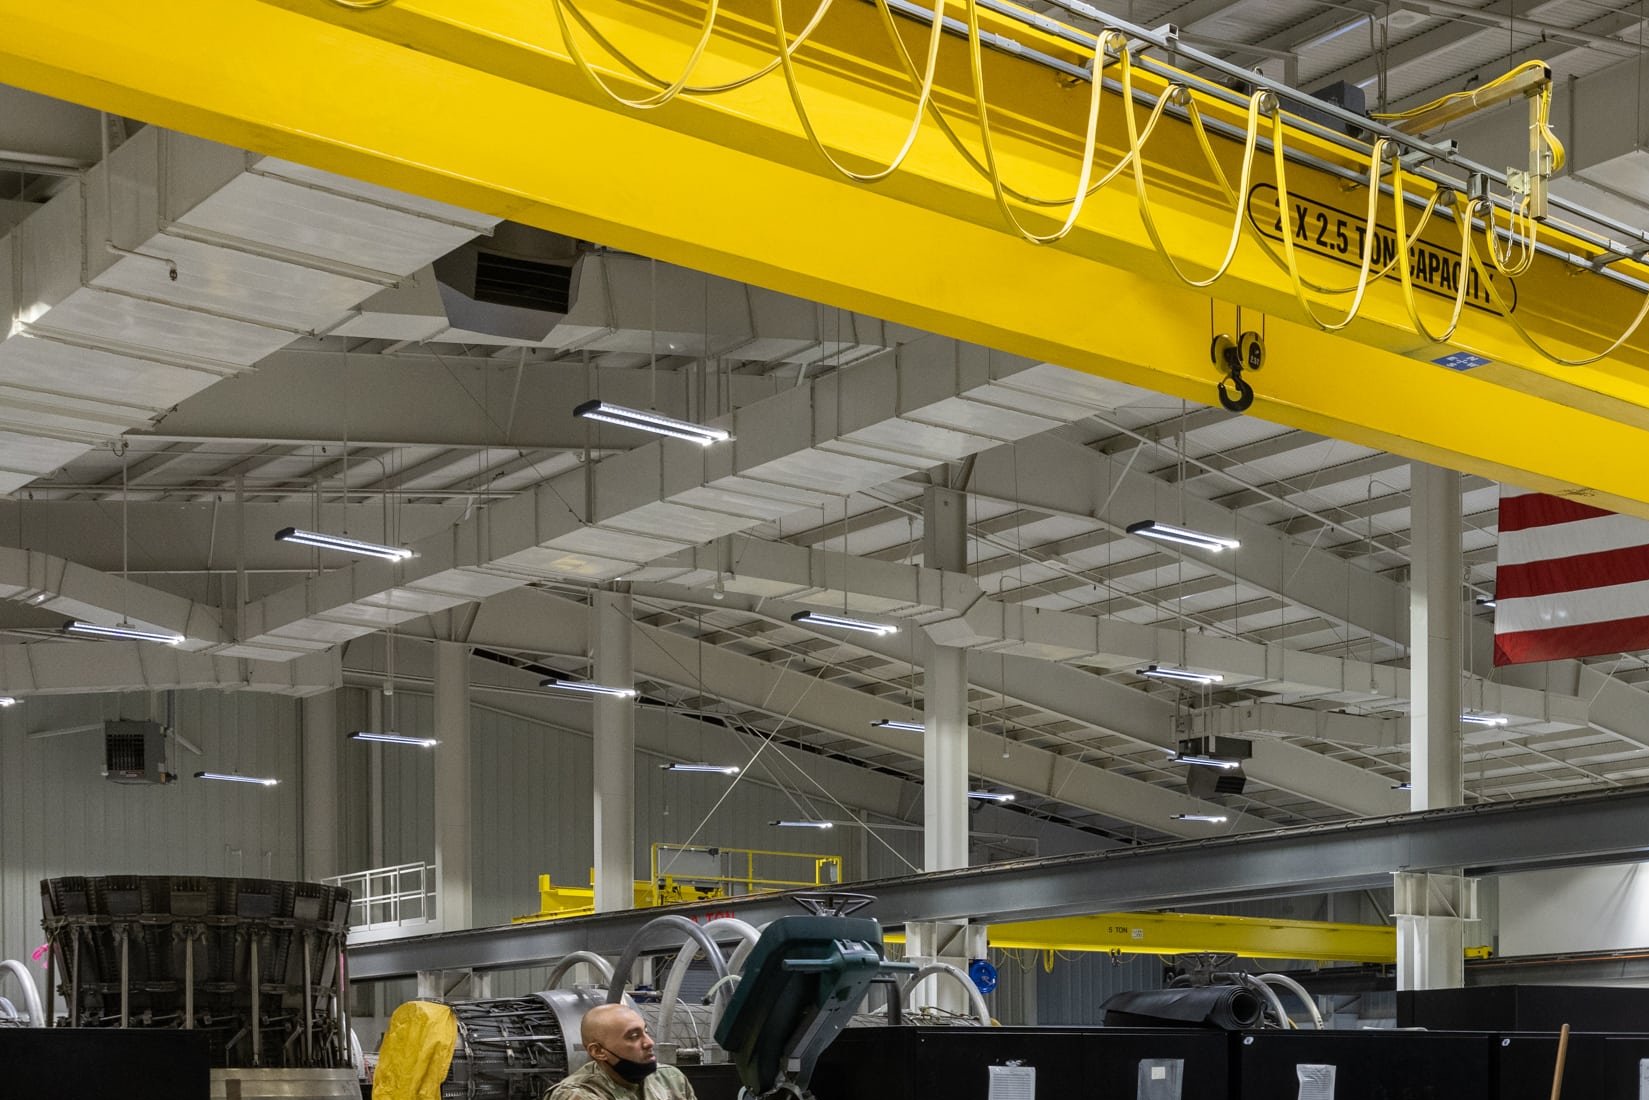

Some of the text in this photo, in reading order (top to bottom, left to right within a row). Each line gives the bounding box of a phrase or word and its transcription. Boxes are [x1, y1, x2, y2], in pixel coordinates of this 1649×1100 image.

[1296, 204, 1308, 241] X
[1316, 212, 1348, 254] 2.5
[1356, 226, 1395, 271] TON
[1408, 246, 1493, 303] CAPACT
